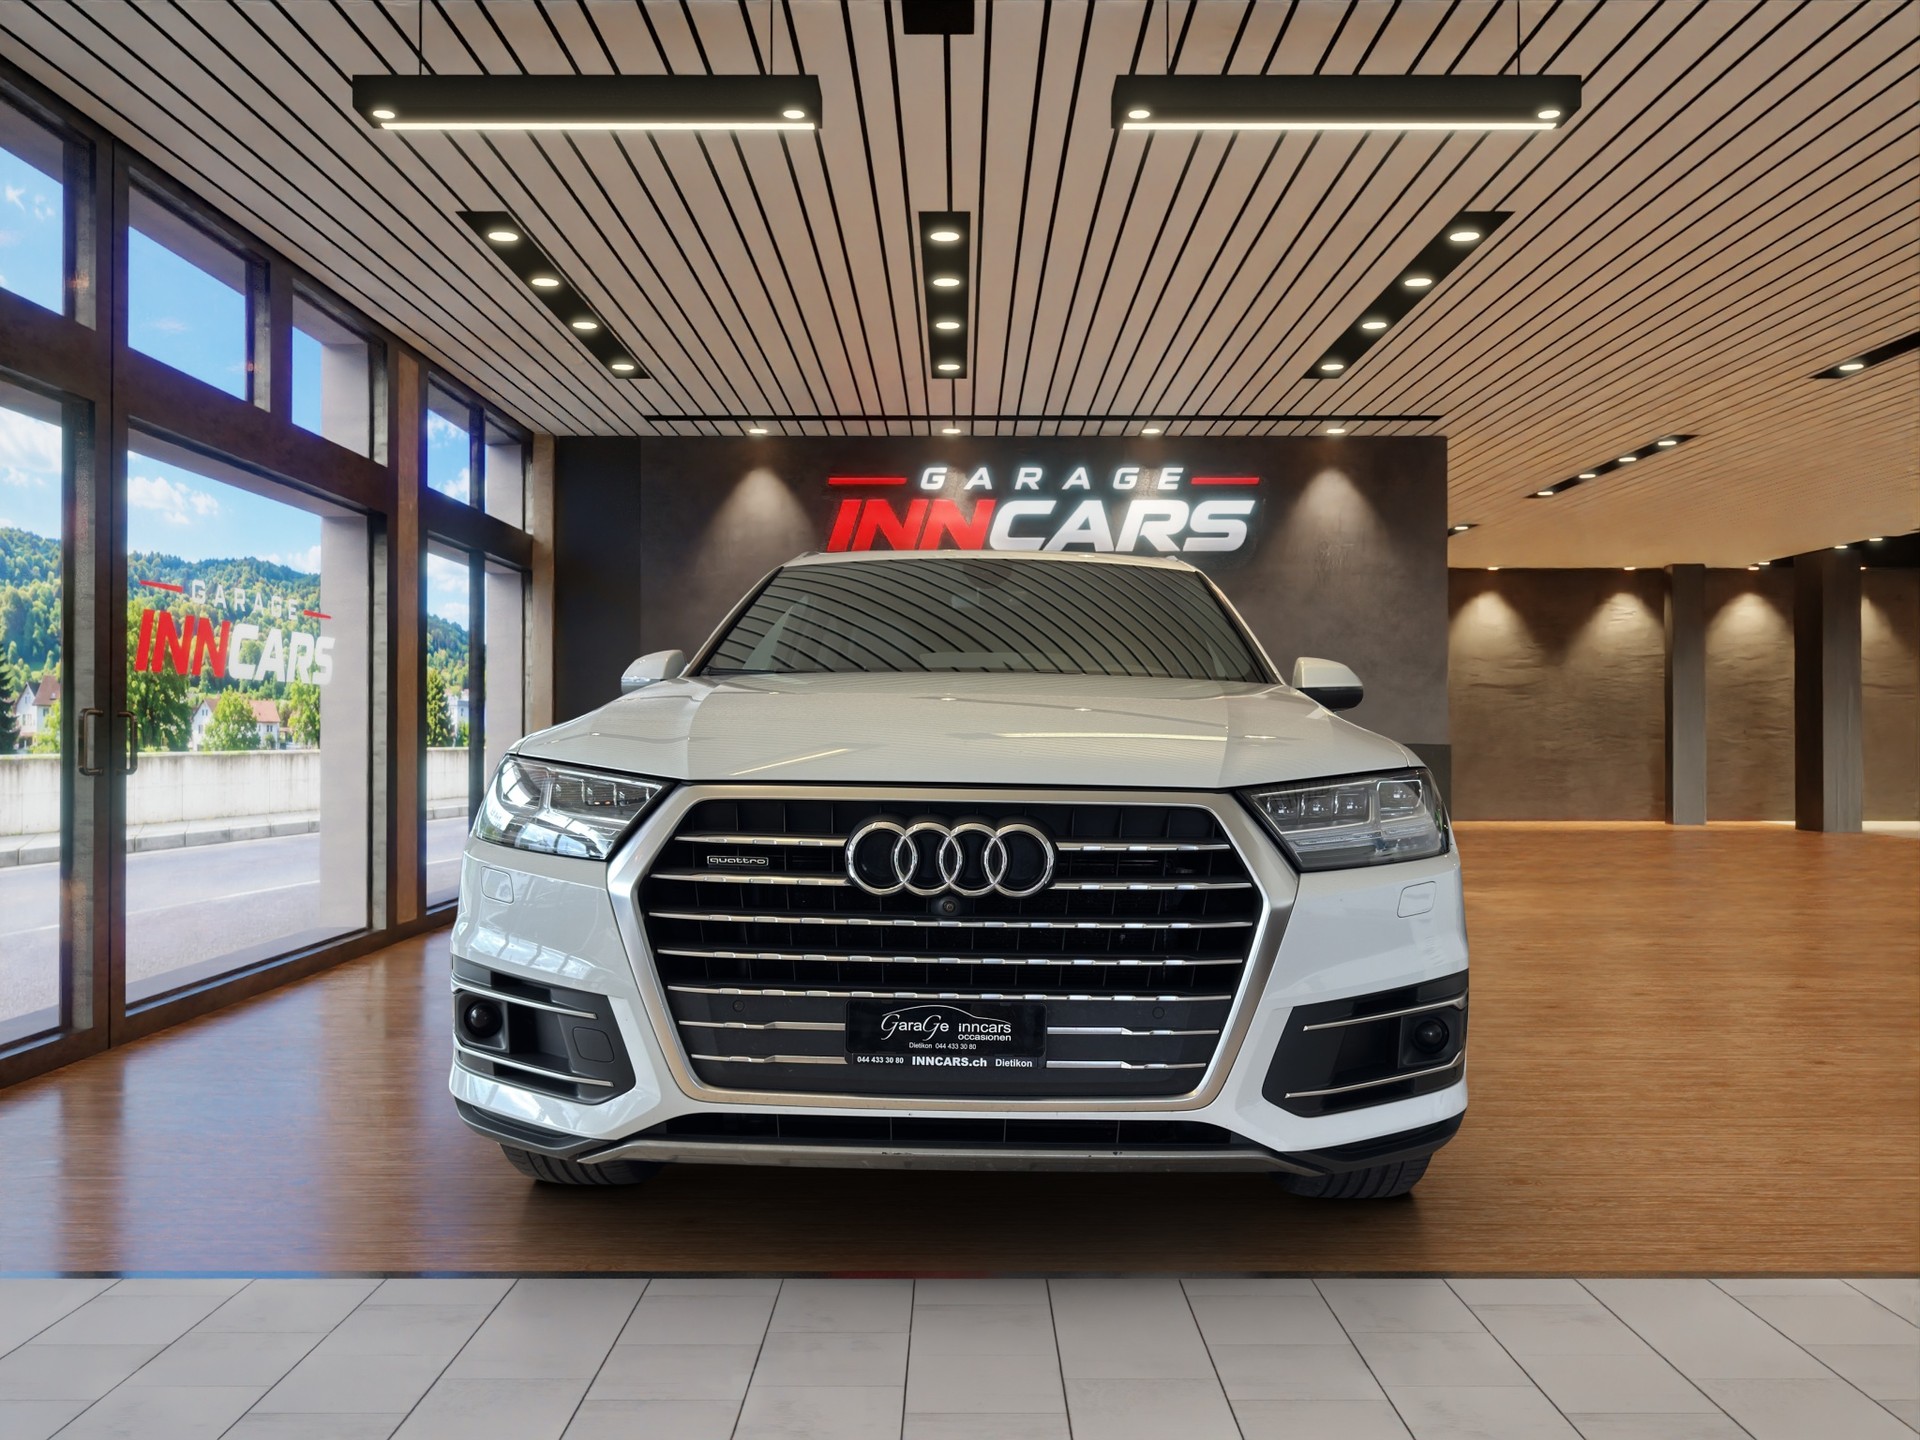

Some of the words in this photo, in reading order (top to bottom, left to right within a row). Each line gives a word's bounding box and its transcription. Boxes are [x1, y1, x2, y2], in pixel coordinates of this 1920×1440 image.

[919, 467, 1184, 490] GARAGE
[826, 499, 1256, 552] INNCARS
[191, 579, 299, 620] GARAGE
[134, 608, 335, 685] INNCARS
[880, 1013, 949, 1041] GaraGe
[958, 1022, 1012, 1034] inncars
[957, 1034, 1012, 1042] occasionen
[895, 1056, 904, 1064] 80
[912, 1056, 987, 1067] INNCARS.ch
[995, 1058, 1033, 1067] Dietikon
